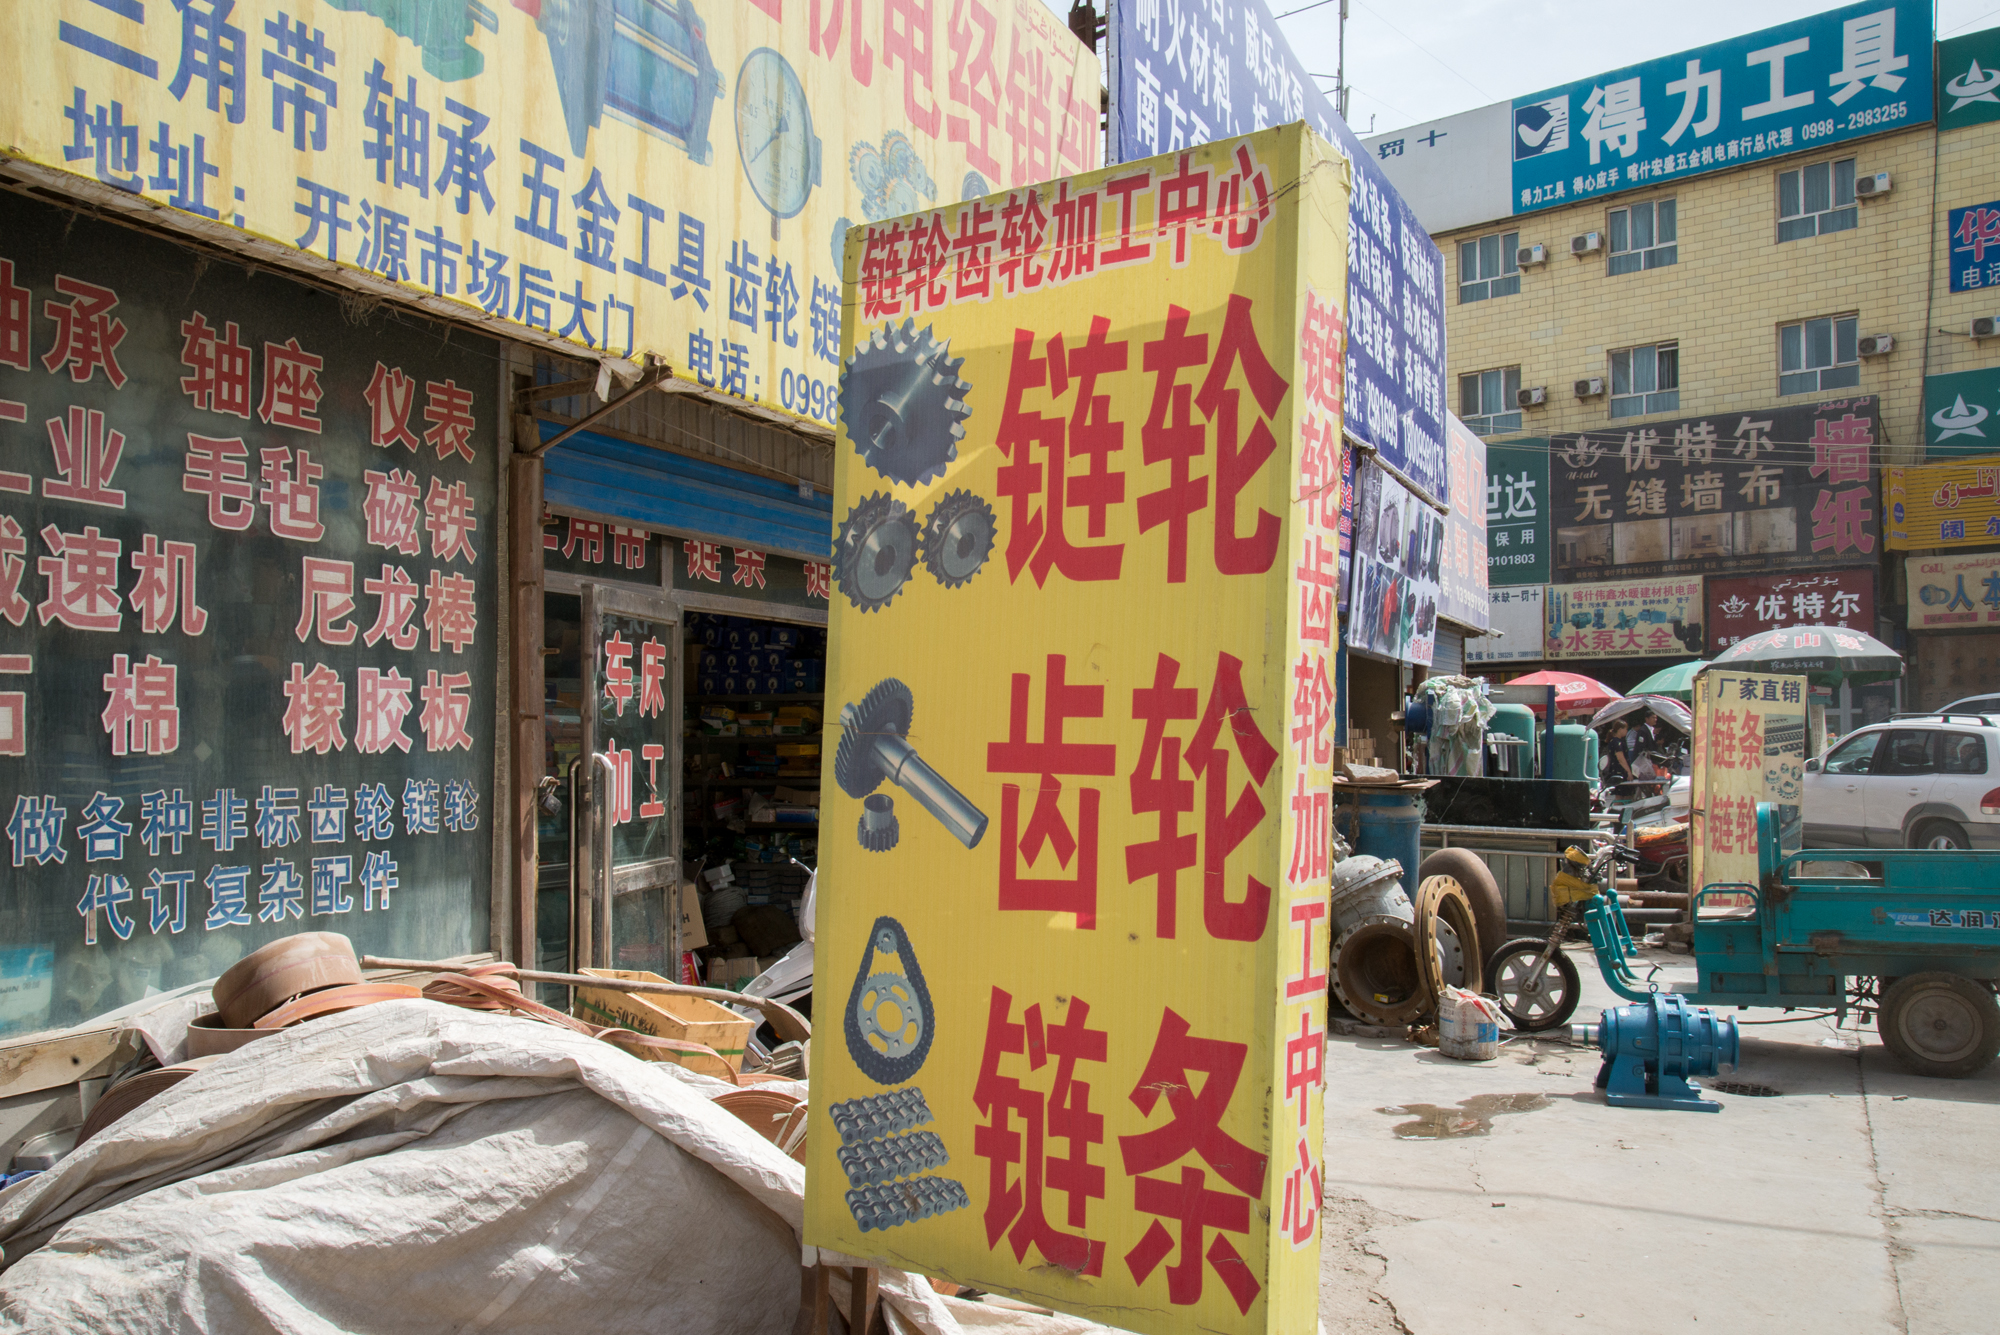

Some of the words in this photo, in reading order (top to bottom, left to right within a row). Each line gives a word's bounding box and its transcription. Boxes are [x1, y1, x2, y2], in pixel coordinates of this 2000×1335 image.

[746, 0, 1097, 187] 机电经销部
[1581, 7, 1909, 165] 得力工具
[363, 57, 496, 216] 轴承
[514, 138, 710, 313] 五金工具
[724, 239, 799, 349] 齿轮
[1521, 180, 1566, 207] 得力工具
[1573, 168, 1619, 195] 得心应手
[1627, 127, 1793, 183] 喀什宏盛五金机电商行总代理
[295, 176, 634, 360] 开源市场后大门
[861, 144, 1271, 319] 链轮齿轮加工中心
[181, 311, 324, 433] 轴座
[363, 361, 475, 463] 仪表
[996, 293, 1290, 590] 链轮
[1620, 416, 1775, 473] 优特尔
[1808, 413, 1875, 554] 墙纸
[183, 433, 325, 542] 毛毡
[363, 468, 477, 564] 磁铁
[1574, 465, 1783, 522] 无缝墙布
[296, 556, 477, 653] 尼龙棒
[1565, 627, 1673, 651] 水泵大全
[1573, 583, 1698, 602] 喀什伟鑫水暖建材机电部
[1754, 590, 1861, 621] 优特尔
[283, 662, 473, 755] 橡胶板
[604, 629, 666, 719] 车床
[1717, 677, 1802, 703] 厂家直销
[605, 738, 665, 826] 加工
[1280, 290, 1344, 1246] 链轮齿轮加工中心
[1711, 707, 1762, 770] 链条
[6, 778, 479, 867] 做各种非标齿轮链轮
[986, 651, 1279, 942] 齿轮
[1709, 794, 1758, 855] 链轮
[77, 851, 399, 945] 代订复杂配件
[972, 985, 1267, 1317] 链条
